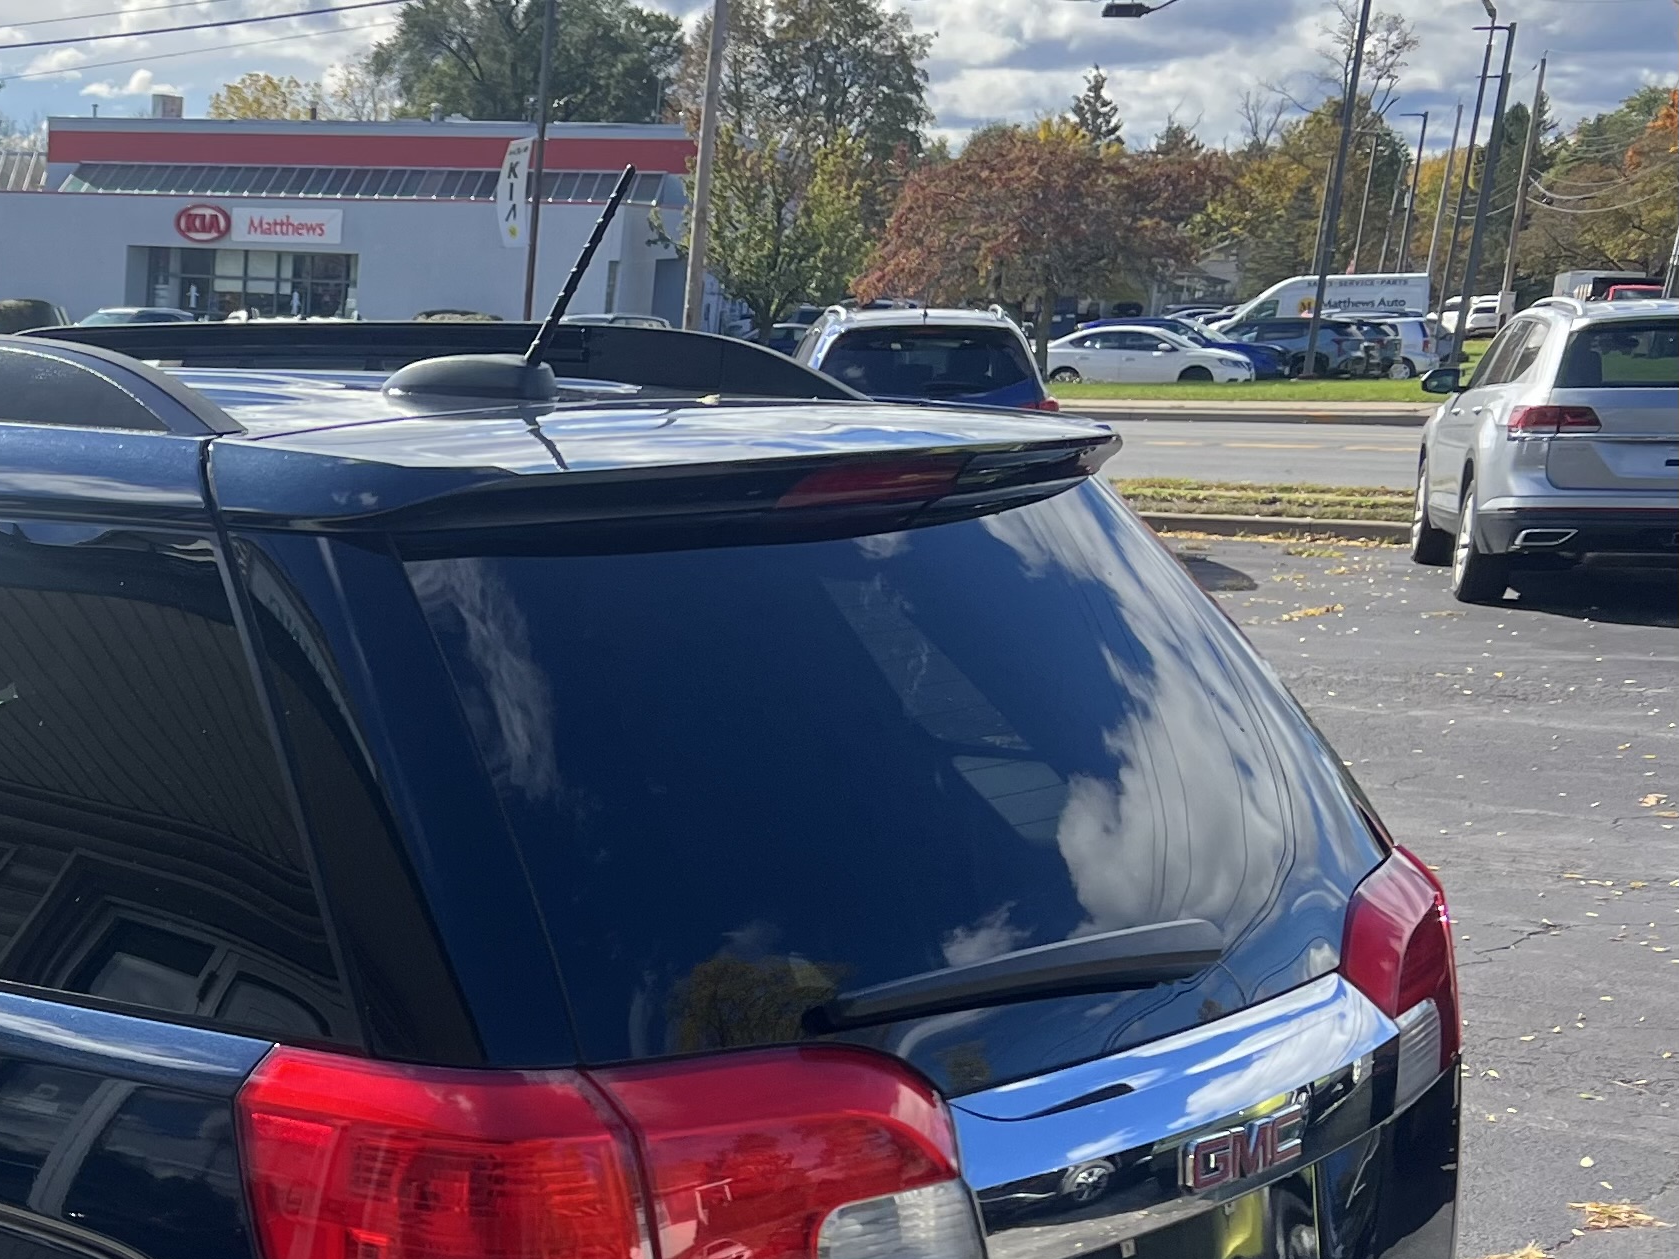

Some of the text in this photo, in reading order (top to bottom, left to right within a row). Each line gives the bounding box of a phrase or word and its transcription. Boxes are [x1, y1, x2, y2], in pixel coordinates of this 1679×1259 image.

[505, 161, 520, 222] KIA
[184, 213, 326, 237] KIA Matthews
[1322, 297, 1407, 309] Matthews Auto
[1182, 1103, 1303, 1191] GMC
